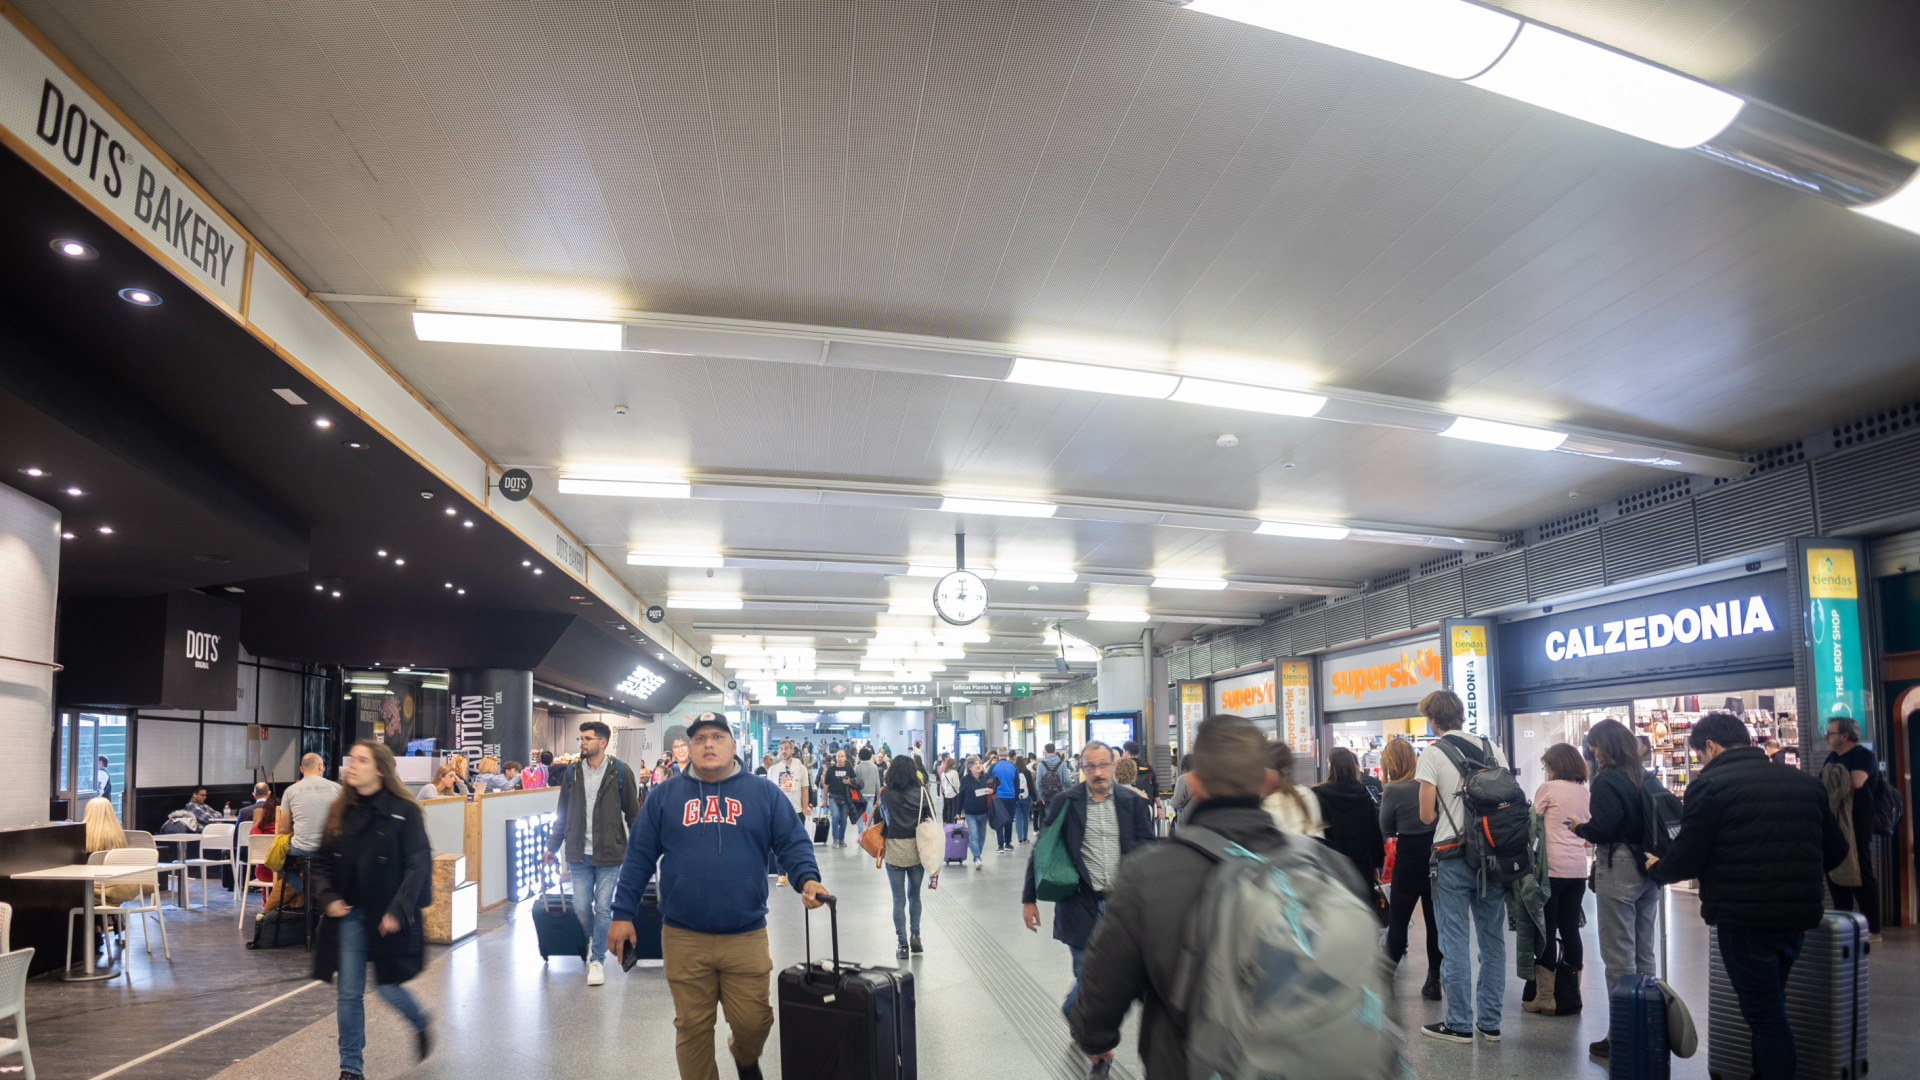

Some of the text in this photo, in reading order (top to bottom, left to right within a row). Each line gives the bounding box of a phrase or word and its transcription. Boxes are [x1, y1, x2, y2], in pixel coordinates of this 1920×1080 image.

[134, 163, 235, 288] BAKERY
[505, 477, 527, 489] DOTS
[556, 534, 568, 562] DOTS
[1812, 574, 1853, 585] tiendas
[1545, 595, 1775, 662] CALZEDONIA
[186, 629, 219, 662] DOTS
[1831, 609, 1845, 698] THE BODY SHOP
[990, 684, 1002, 692] Baja
[483, 696, 494, 730] QUALITY
[682, 795, 742, 827] GAP
